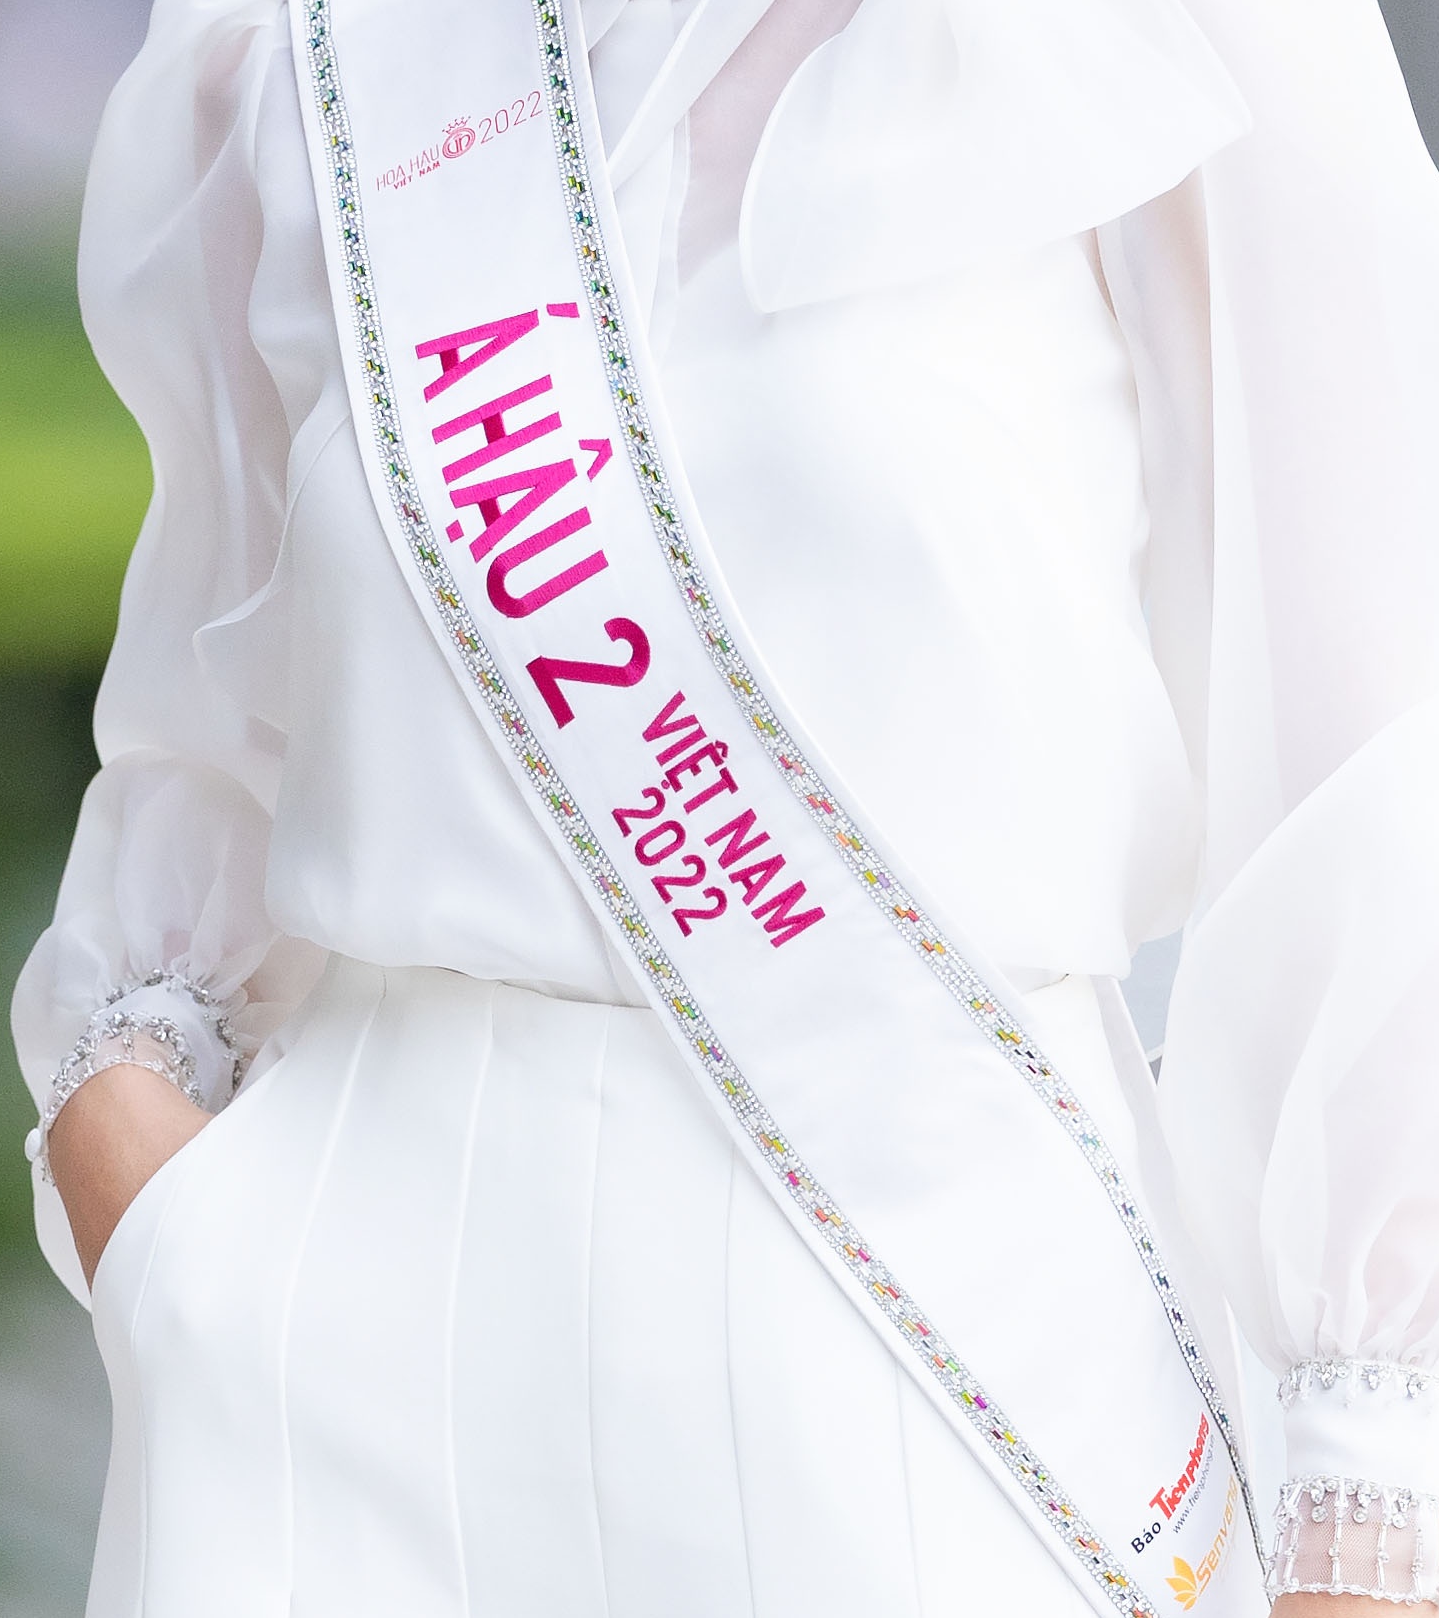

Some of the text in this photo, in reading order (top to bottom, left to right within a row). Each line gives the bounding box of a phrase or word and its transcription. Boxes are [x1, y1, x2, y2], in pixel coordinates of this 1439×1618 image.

[478, 91, 543, 144] 2022
[376, 164, 406, 191] HOA
[419, 160, 441, 177] NAM
[415, 302, 651, 729] Á HẬU 2
[642, 690, 826, 948] VIỆT NAM
[612, 787, 728, 937] 2022
[1130, 1522, 1162, 1554] Báo
